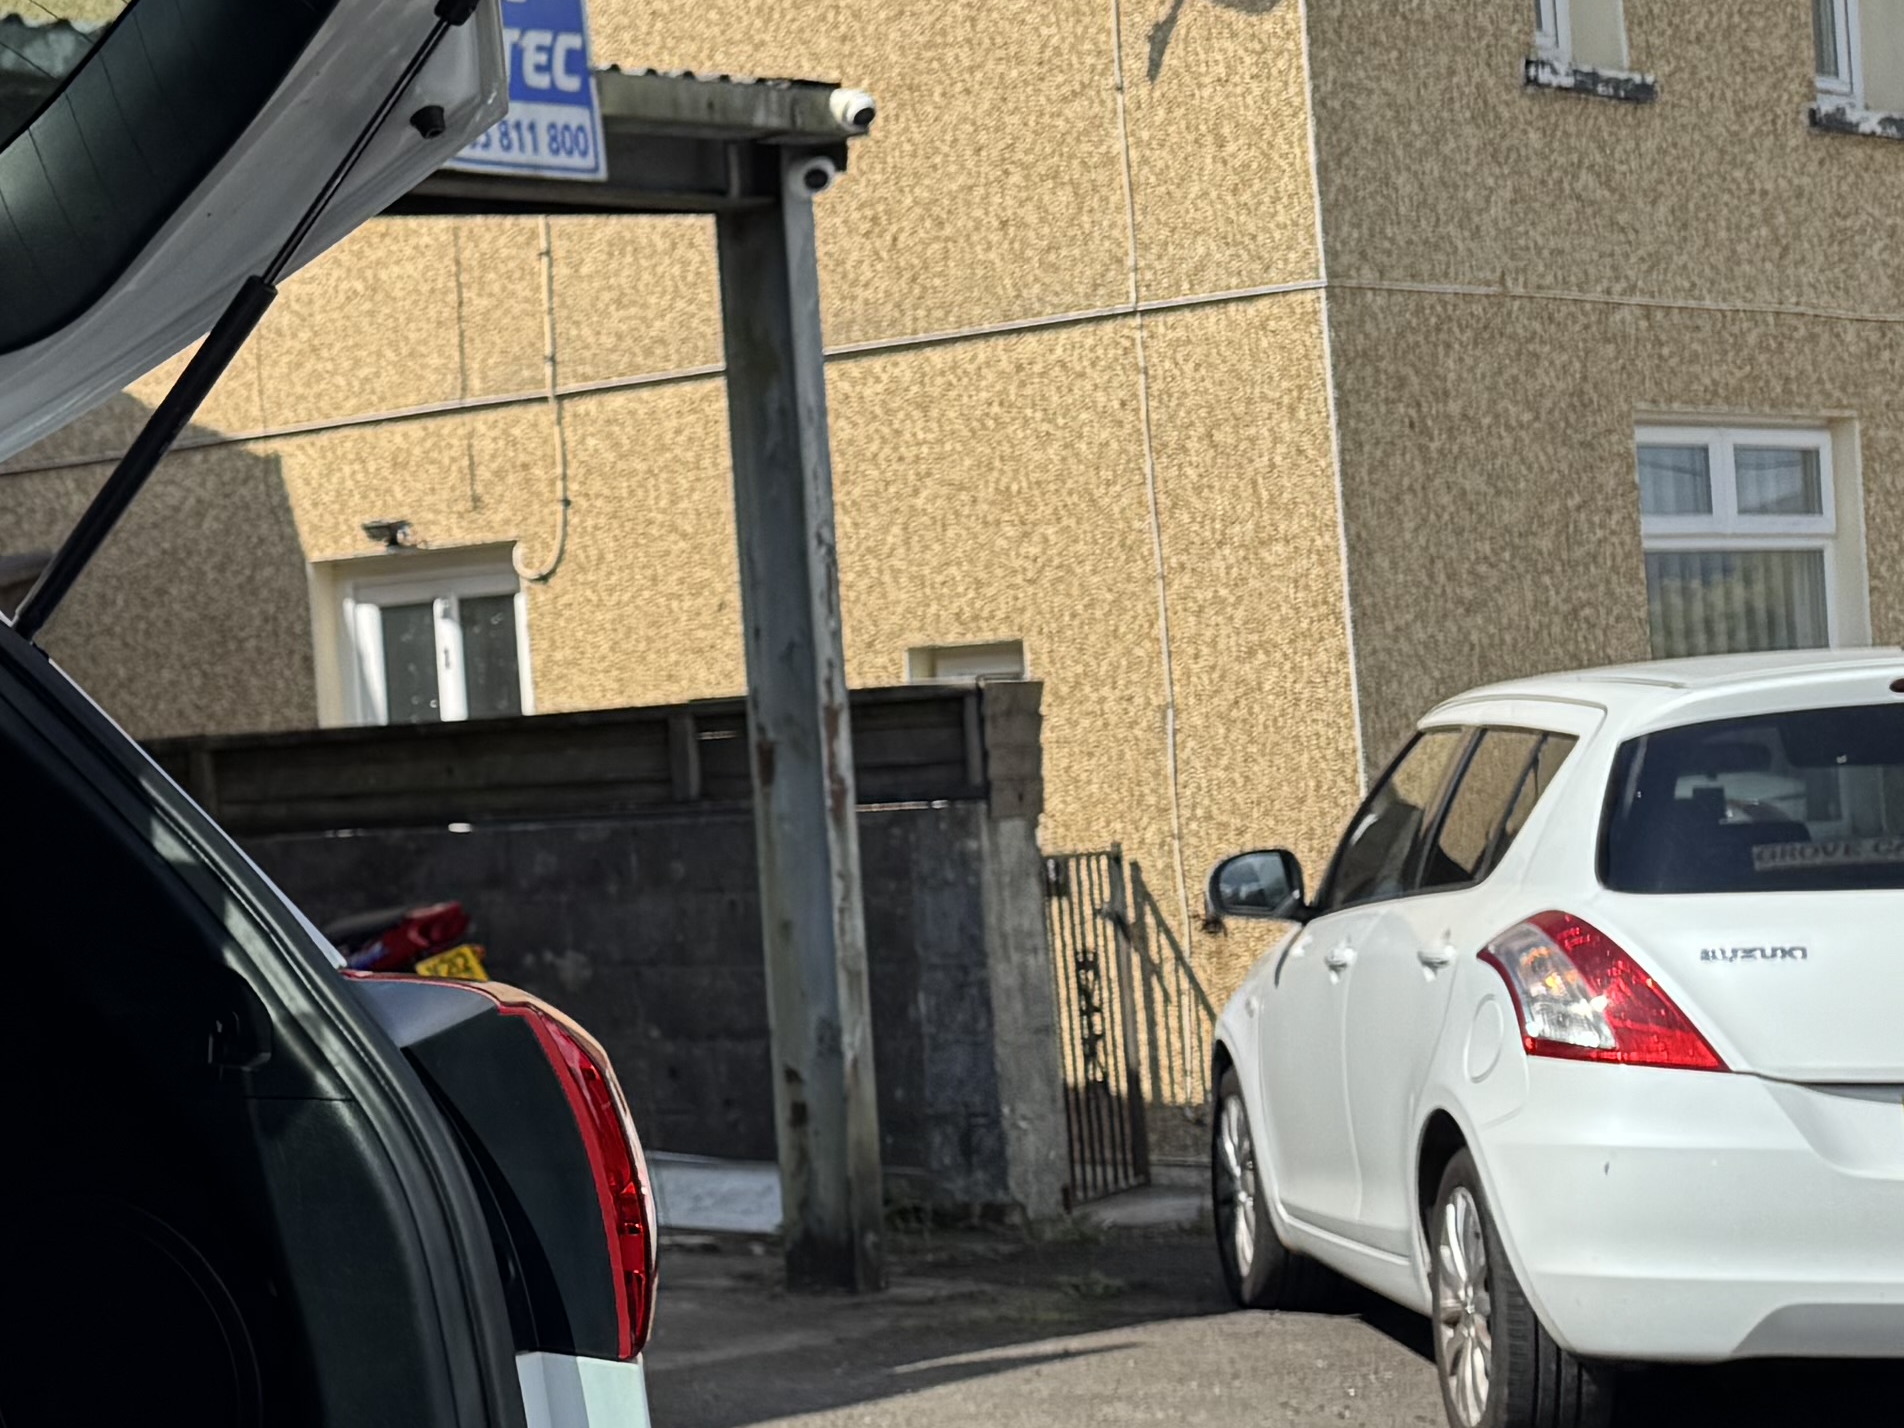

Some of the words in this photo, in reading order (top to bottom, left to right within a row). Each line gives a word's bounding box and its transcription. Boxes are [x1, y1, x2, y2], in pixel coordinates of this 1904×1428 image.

[499, 119, 539, 155] 811
[548, 122, 589, 159] 800
[1699, 946, 1808, 963] SUZUKI
